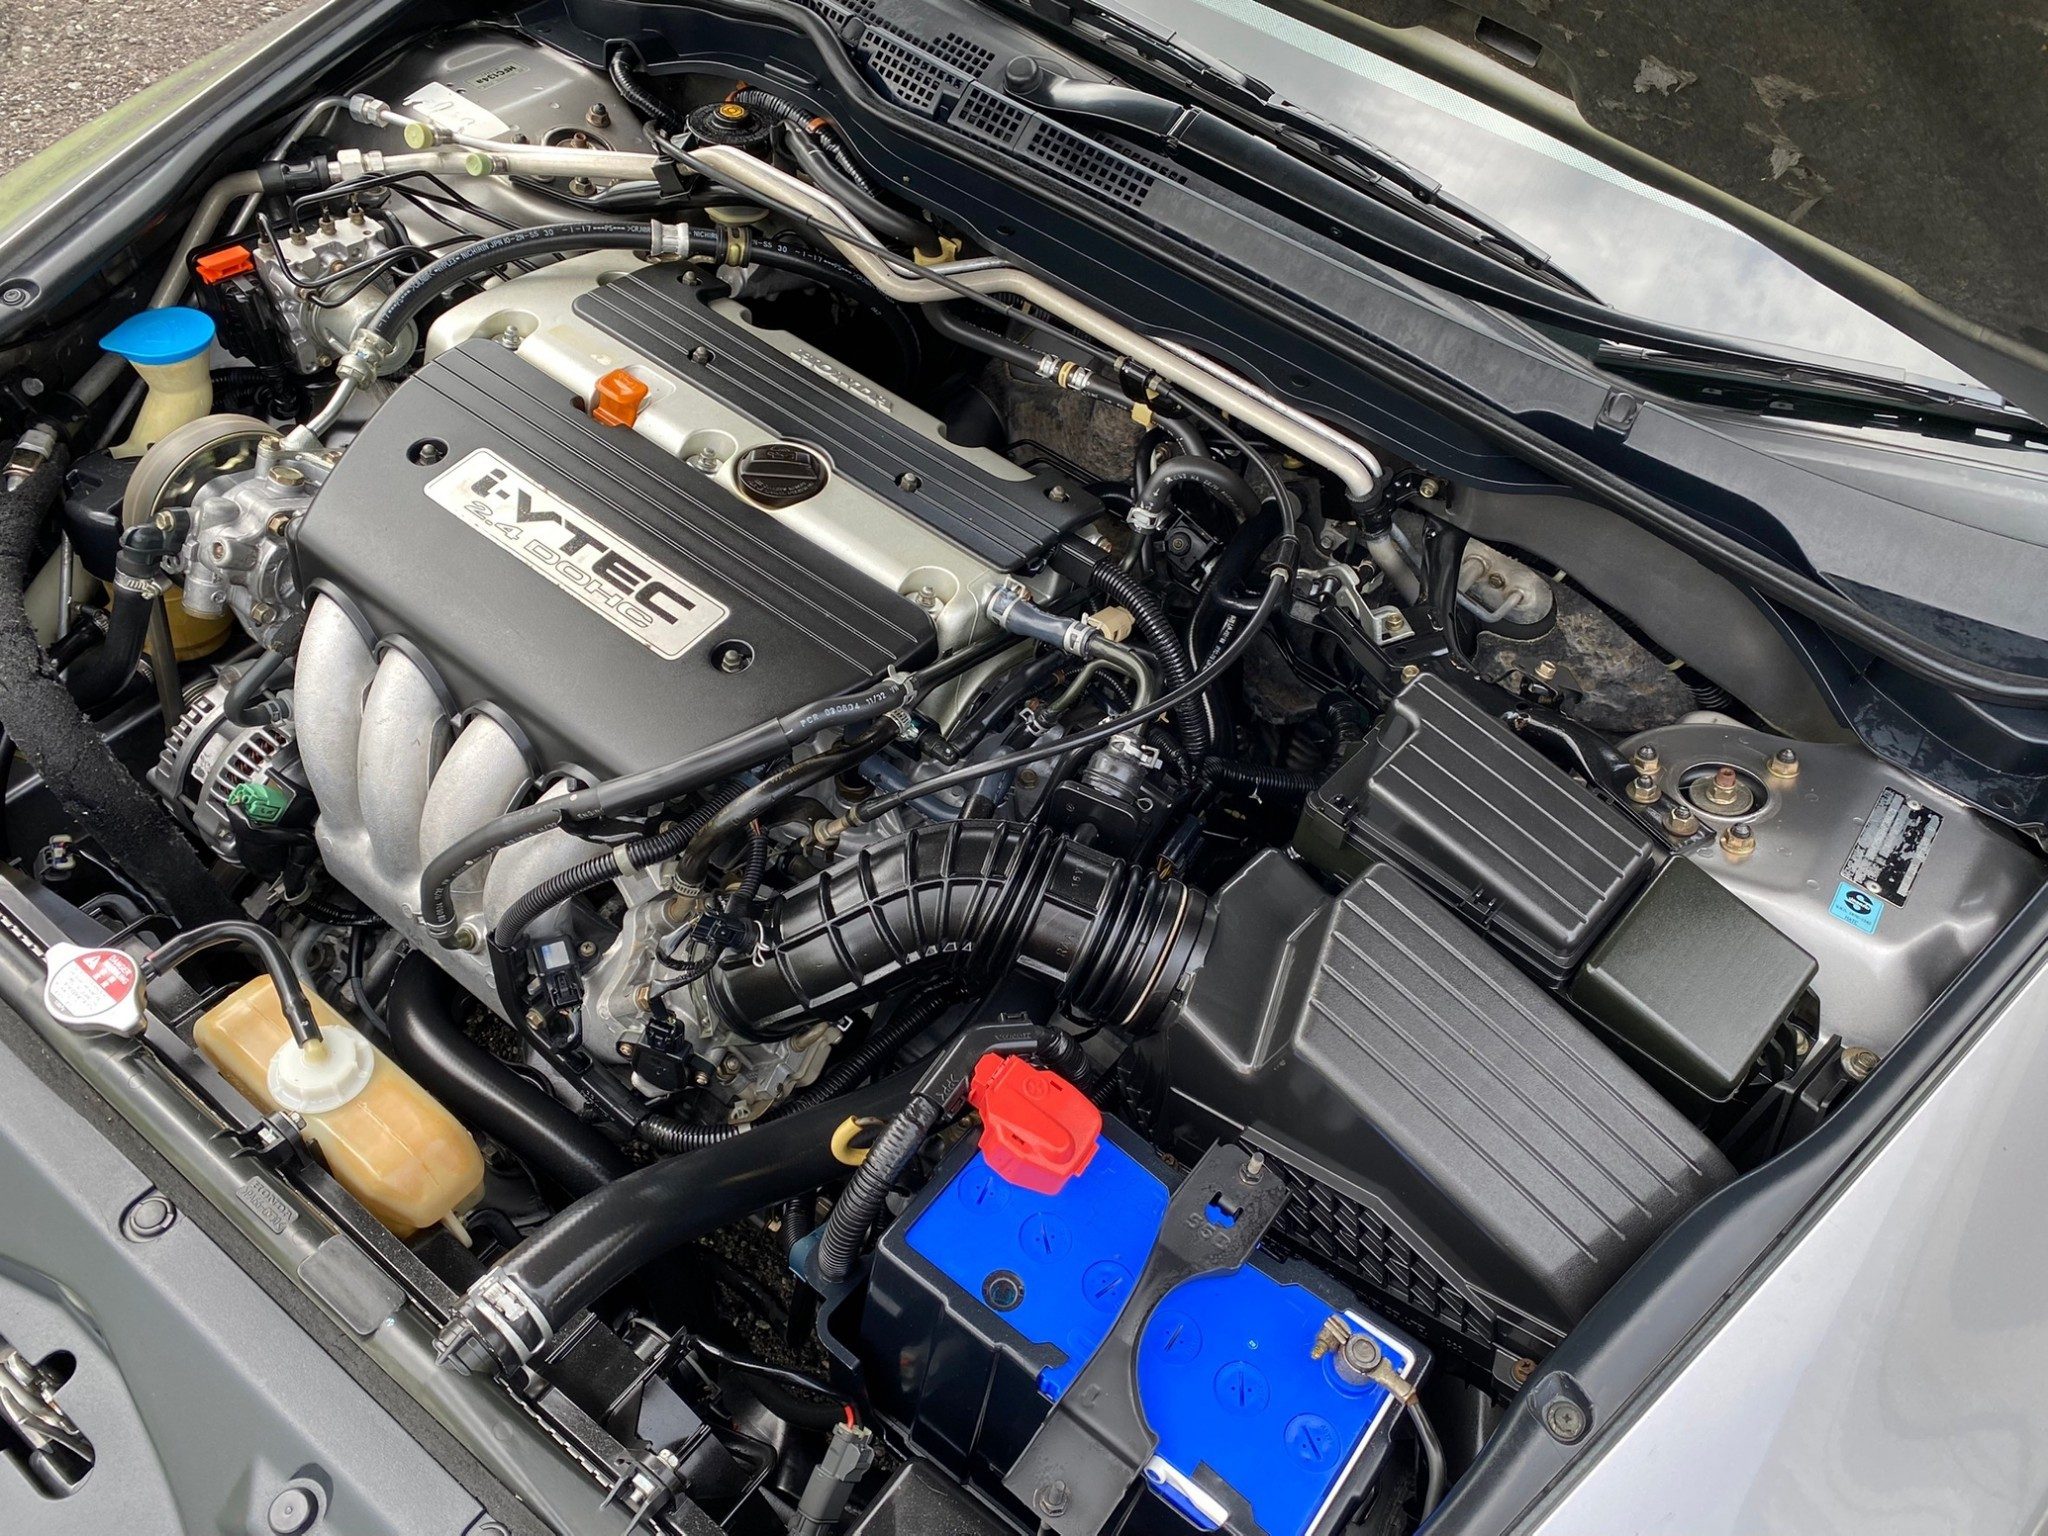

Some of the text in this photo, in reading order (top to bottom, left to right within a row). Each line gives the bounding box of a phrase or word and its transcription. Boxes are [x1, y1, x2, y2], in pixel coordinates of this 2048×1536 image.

[789, 348, 894, 413] HONDA
[464, 501, 654, 629] 2.4 DOHC
[471, 468, 697, 626] i-VTEC
[252, 1180, 293, 1221] HONDA
